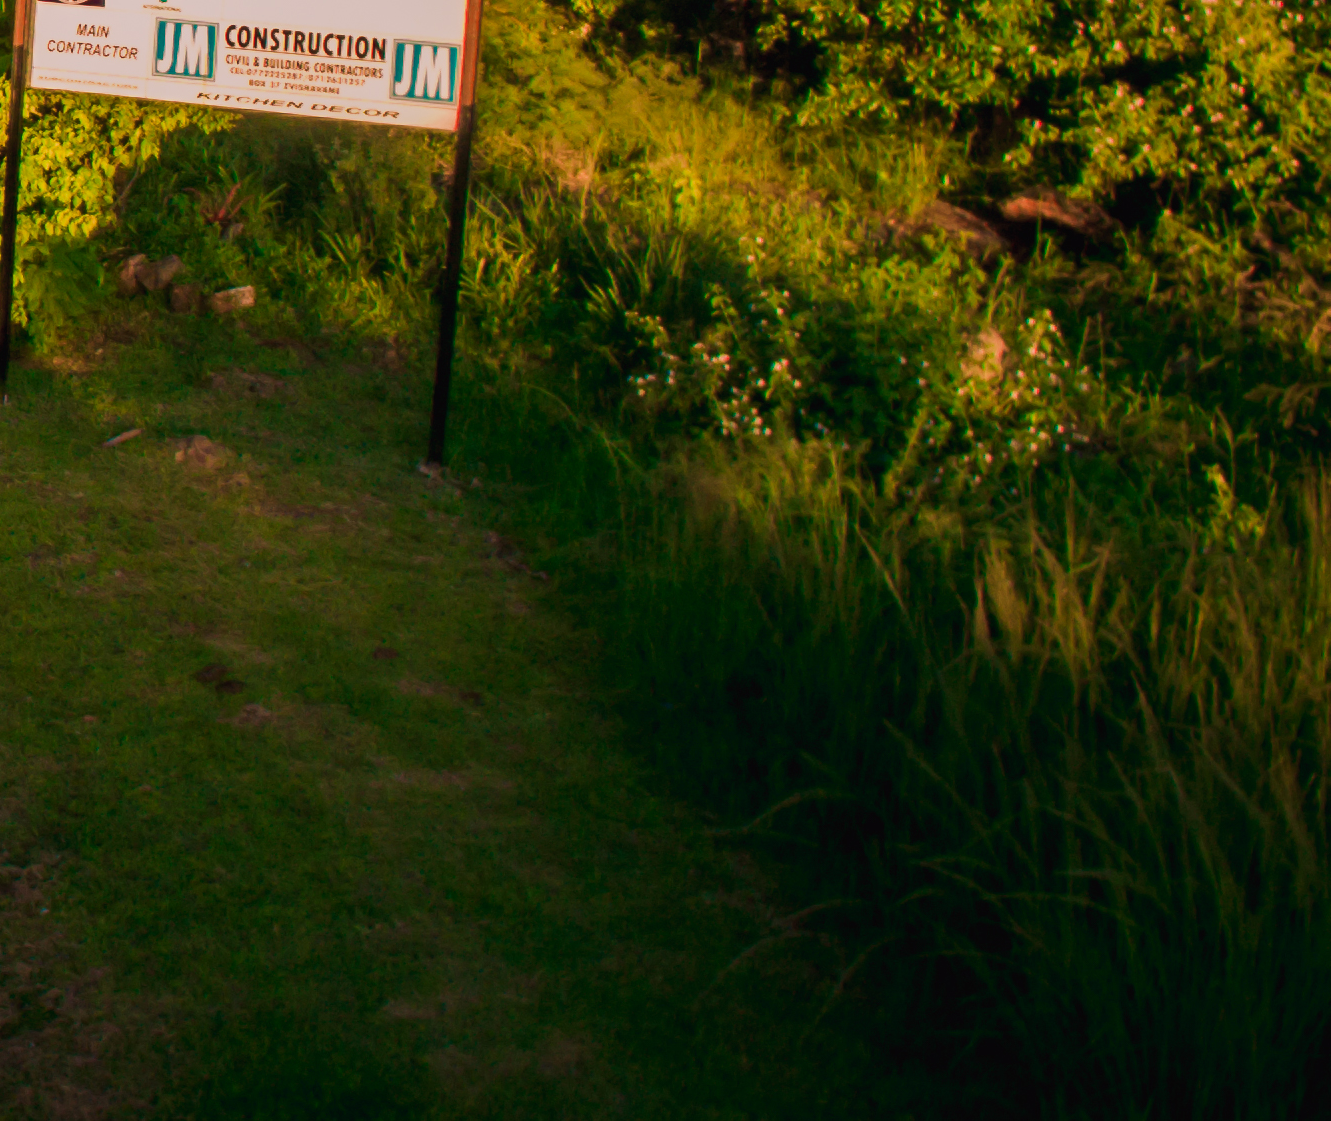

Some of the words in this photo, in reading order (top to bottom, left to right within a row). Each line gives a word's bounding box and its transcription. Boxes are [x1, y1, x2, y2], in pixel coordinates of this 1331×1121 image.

[76, 24, 110, 38] MAIN
[225, 24, 387, 60] CONSTRUCTION
[47, 39, 139, 60] CONTRACTOR
[156, 21, 210, 76] JM
[225, 54, 250, 66] CIVIL
[253, 56, 260, 67] &
[263, 57, 310, 72] BUILDING
[313, 62, 384, 78] CONTRACTORS
[394, 43, 451, 100] JM
[196, 92, 304, 109] KITCHEN
[310, 103, 400, 119] DECOR
